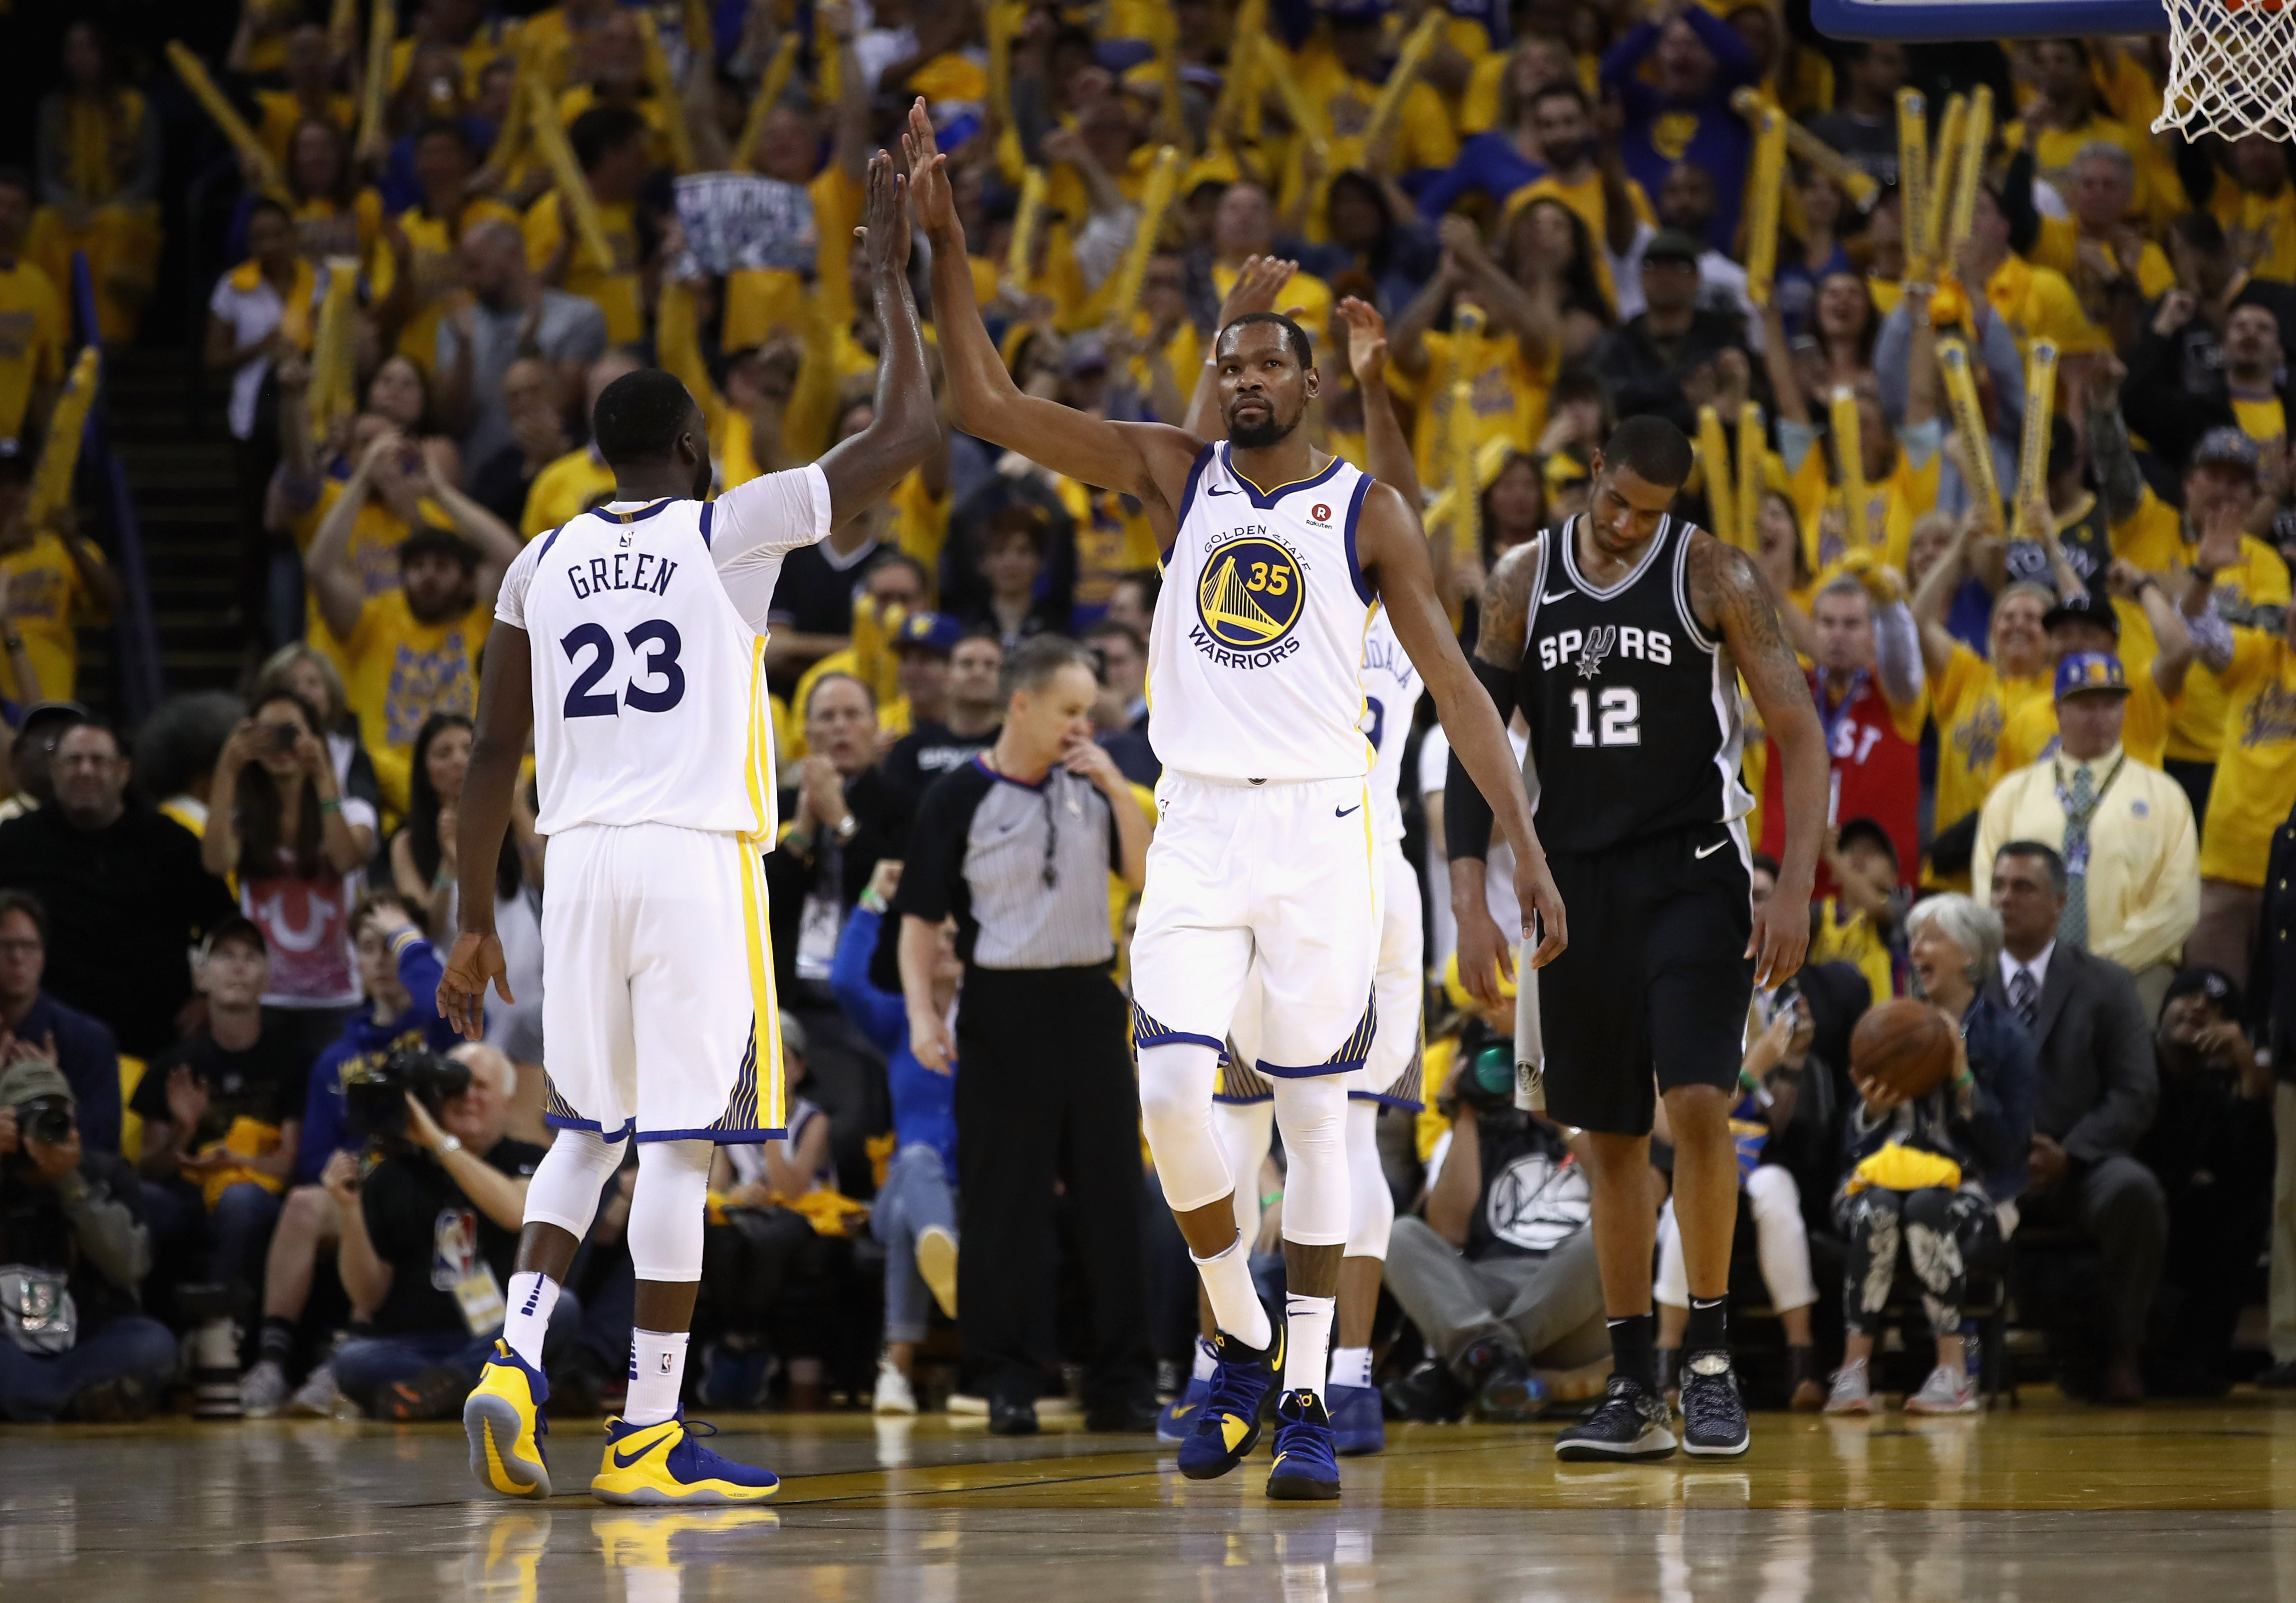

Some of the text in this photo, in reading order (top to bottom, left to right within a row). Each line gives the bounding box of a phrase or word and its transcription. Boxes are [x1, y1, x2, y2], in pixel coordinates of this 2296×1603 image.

[1204, 524, 1267, 553] GOLDEN
[1306, 519, 1332, 530] Rakuten
[568, 553, 678, 600] GREEN
[1246, 562, 1291, 596] 35
[560, 619, 686, 721] 23
[1188, 623, 1301, 670] WARRIORS
[1539, 625, 1672, 680] SPURS
[1570, 686, 1641, 748] 12
